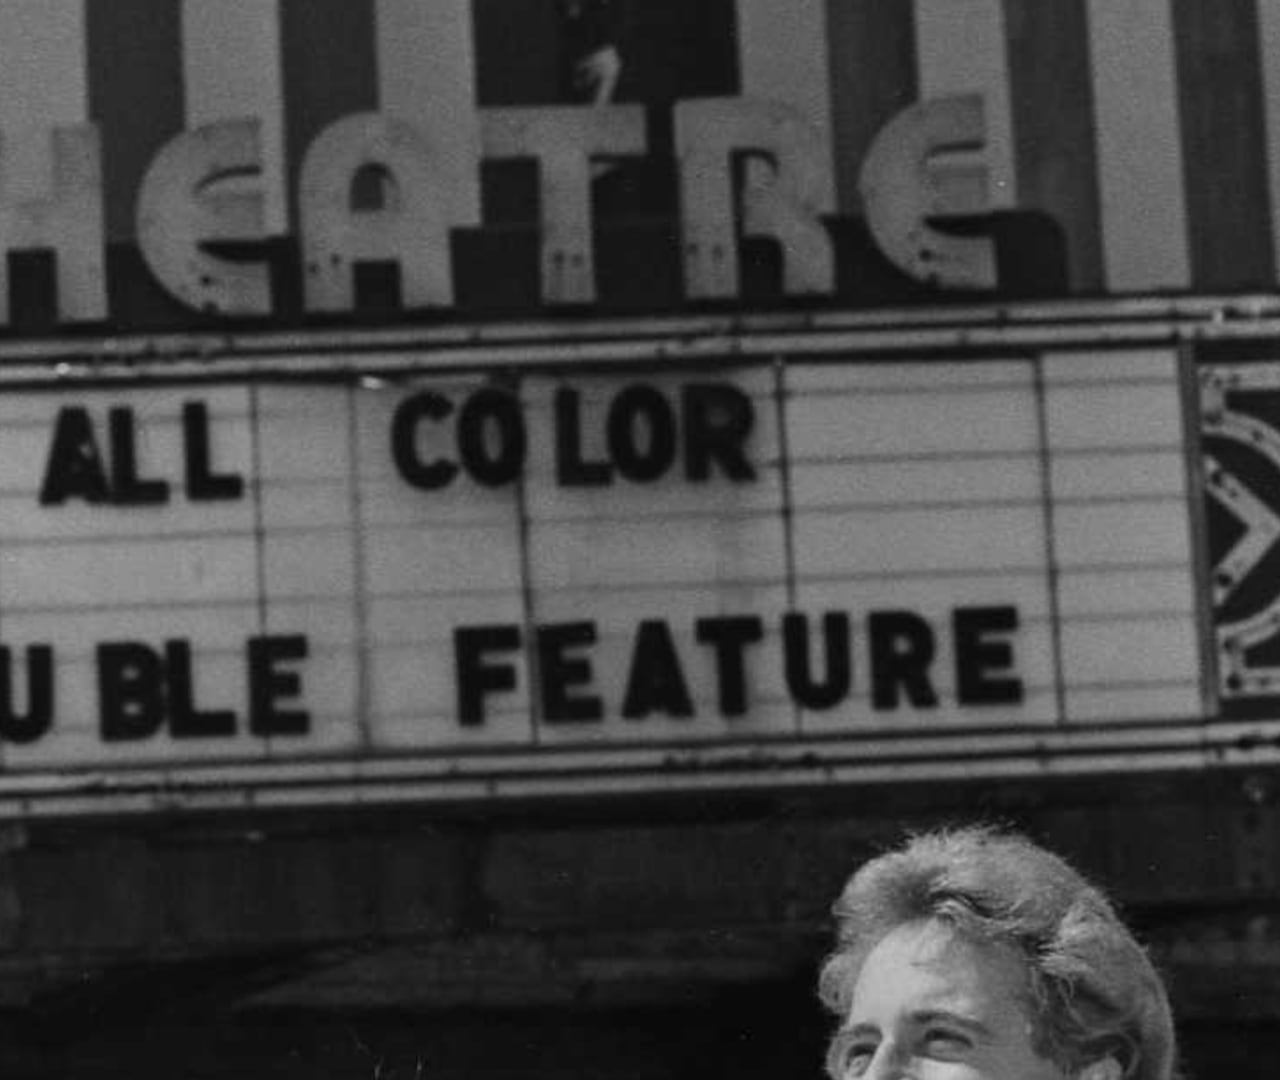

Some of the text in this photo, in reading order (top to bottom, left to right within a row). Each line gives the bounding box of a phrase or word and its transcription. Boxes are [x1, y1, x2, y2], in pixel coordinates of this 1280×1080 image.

[39, 383, 758, 506] ALL COLOR
[452, 605, 1023, 727] FEATURE
